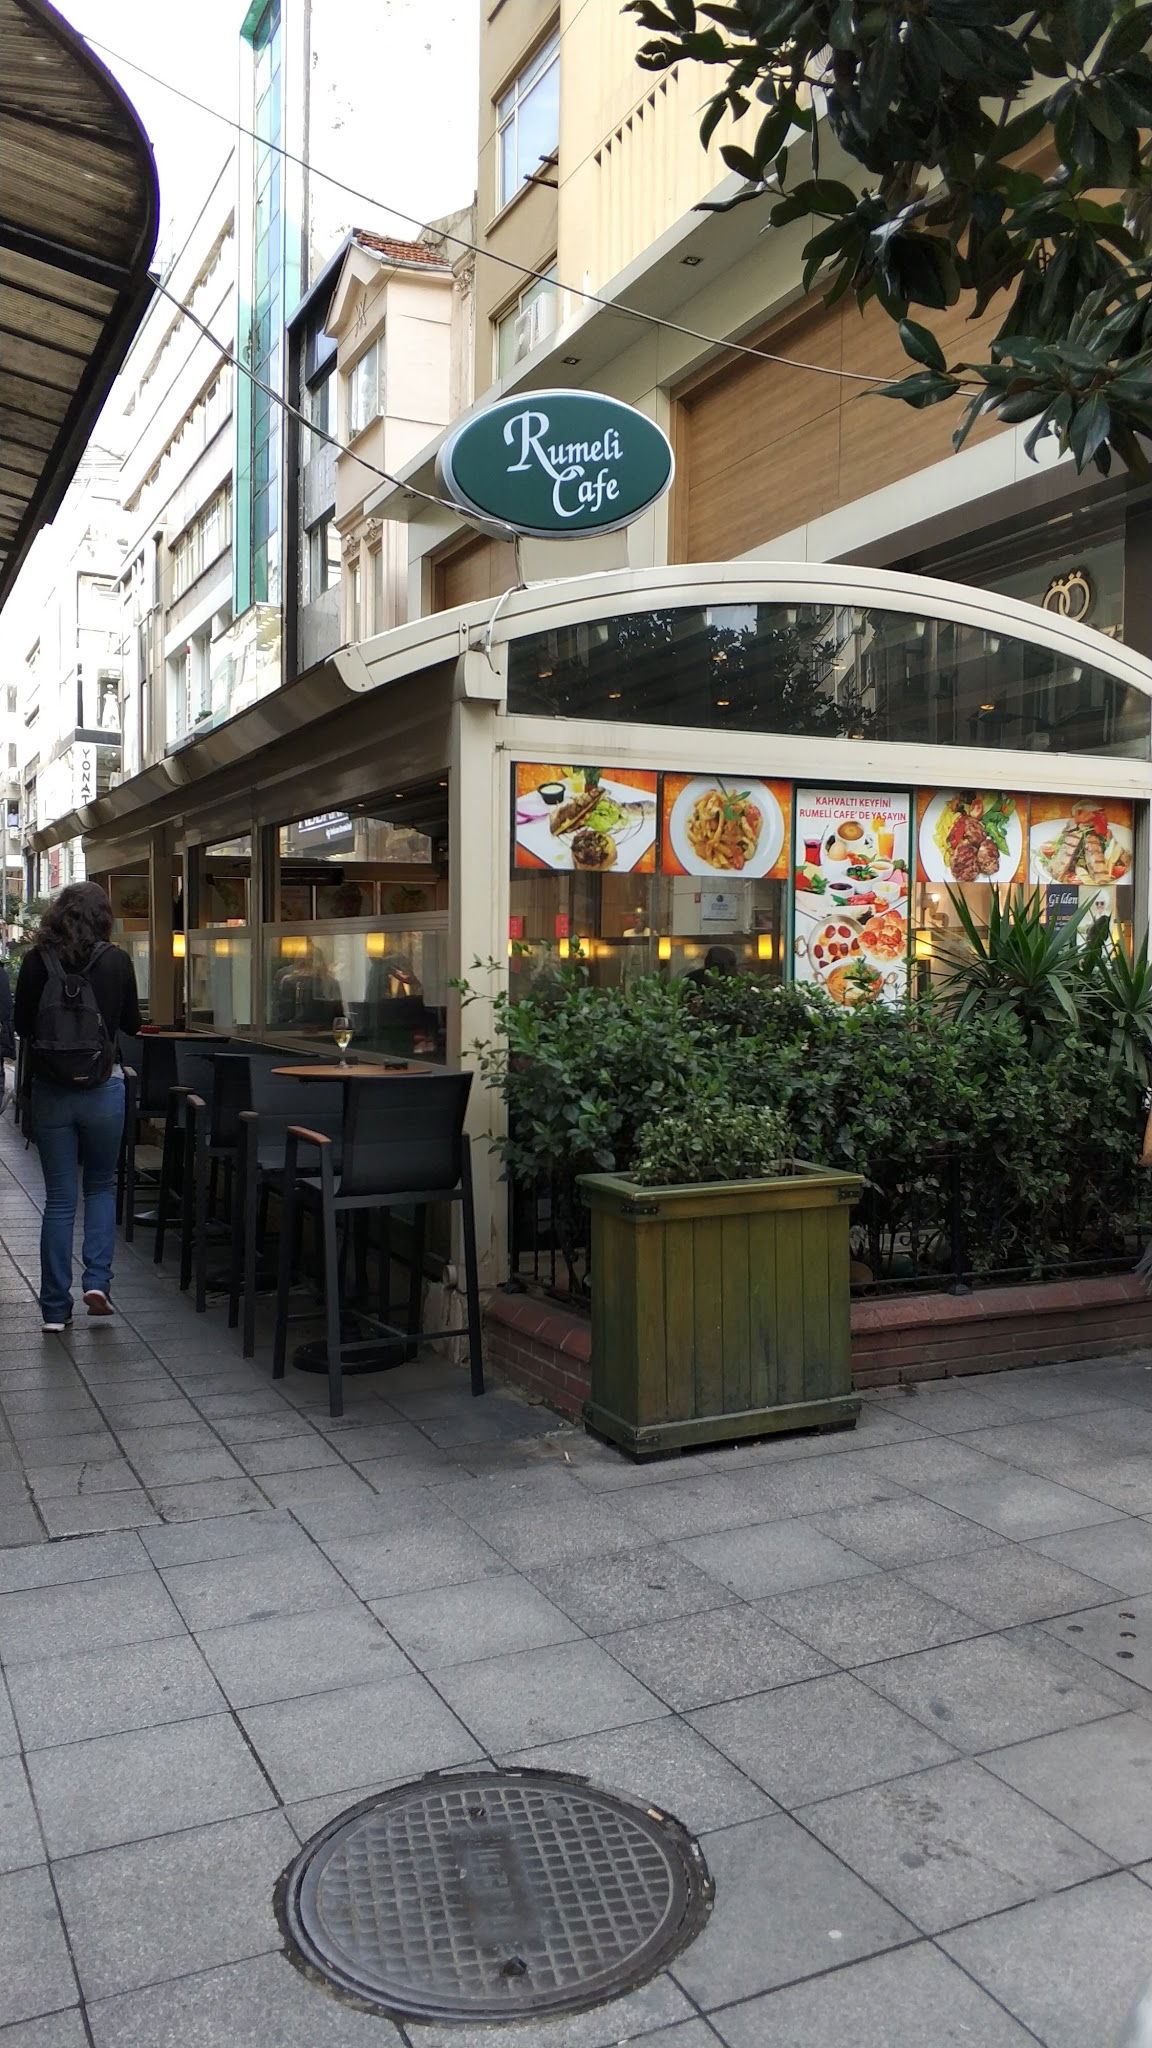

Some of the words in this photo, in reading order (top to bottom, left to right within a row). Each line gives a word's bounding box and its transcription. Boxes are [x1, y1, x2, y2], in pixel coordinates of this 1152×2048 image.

[503, 410, 623, 480] Rumeli
[553, 465, 620, 517] Cafe
[799, 807, 832, 818] RUMELİ
[858, 811, 870, 820] DE
[815, 796, 857, 807] KAHVALTI
